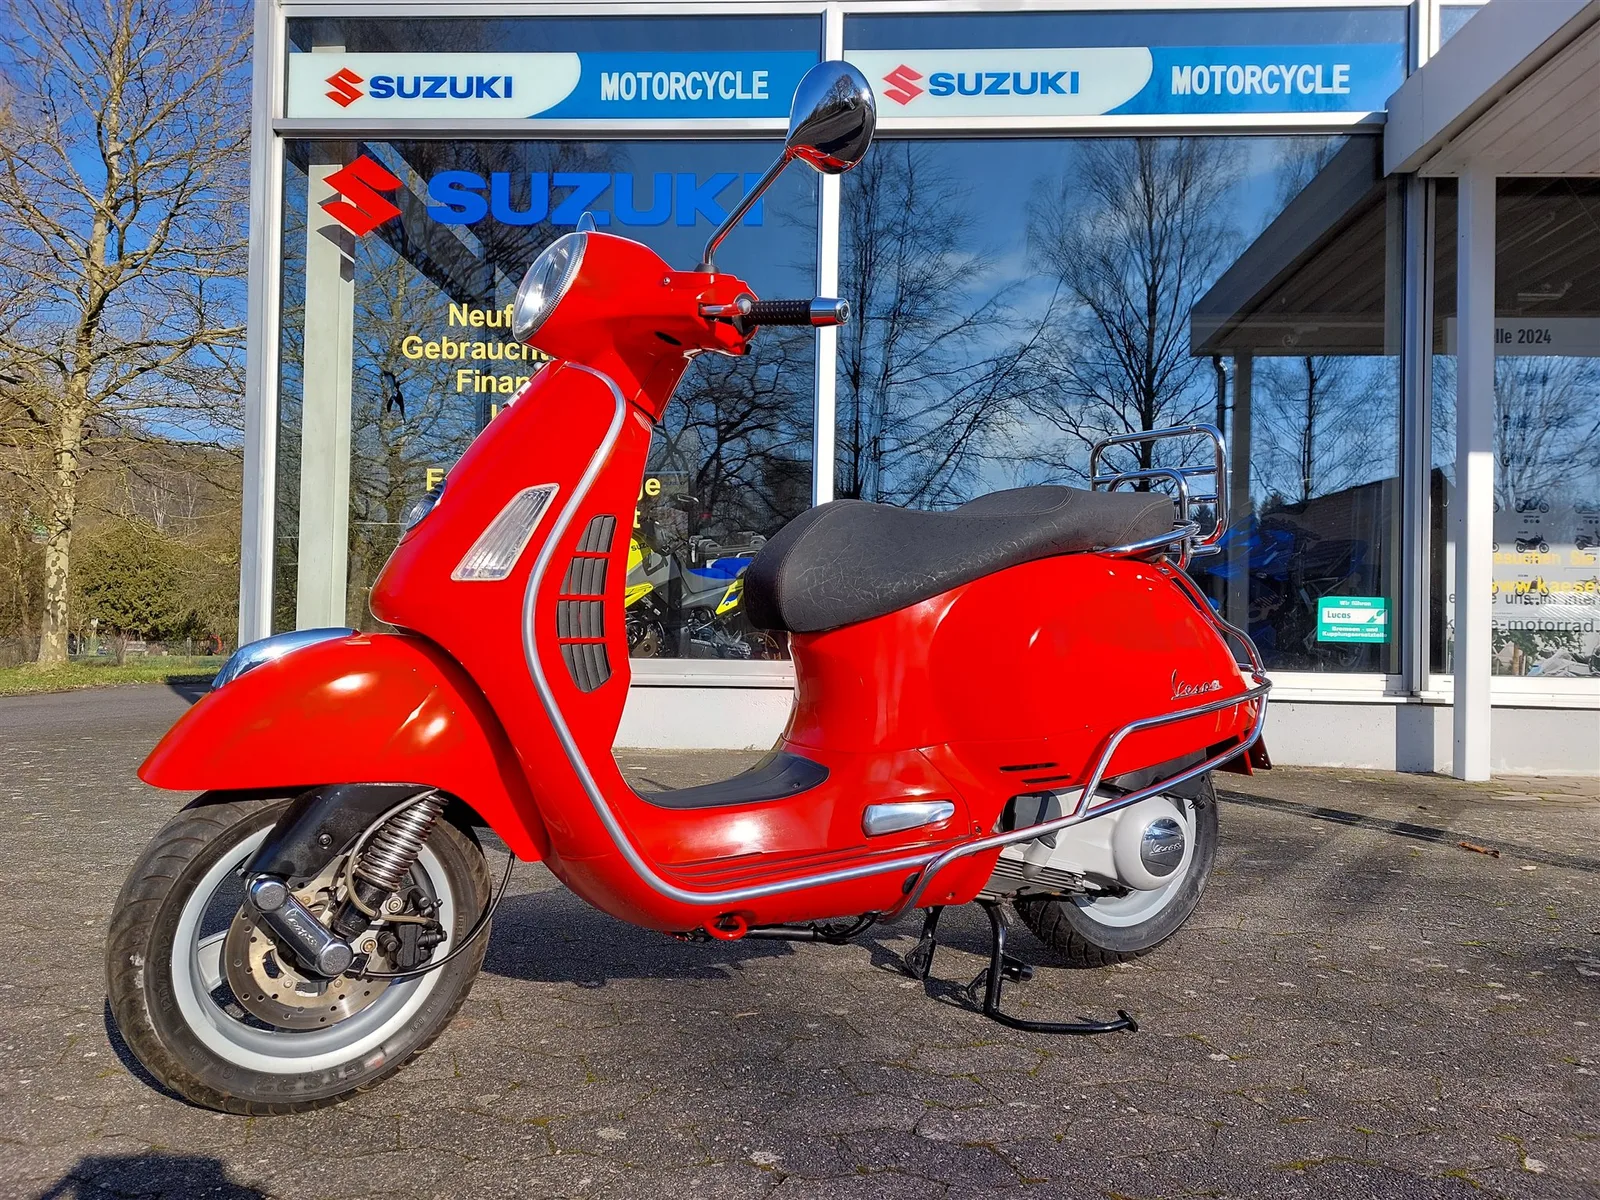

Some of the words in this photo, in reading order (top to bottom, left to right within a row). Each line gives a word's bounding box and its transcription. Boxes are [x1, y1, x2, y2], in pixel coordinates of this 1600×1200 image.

[369, 75, 513, 99] SUZUKI
[601, 70, 769, 101] MOTORCYCLE
[928, 71, 1080, 97] SUZUKI
[1171, 63, 1351, 96] MOTORCYCLE
[1517, 329, 1552, 344] 2024
[1327, 610, 1351, 619] Lucas
[1171, 668, 1223, 700] Vespa
